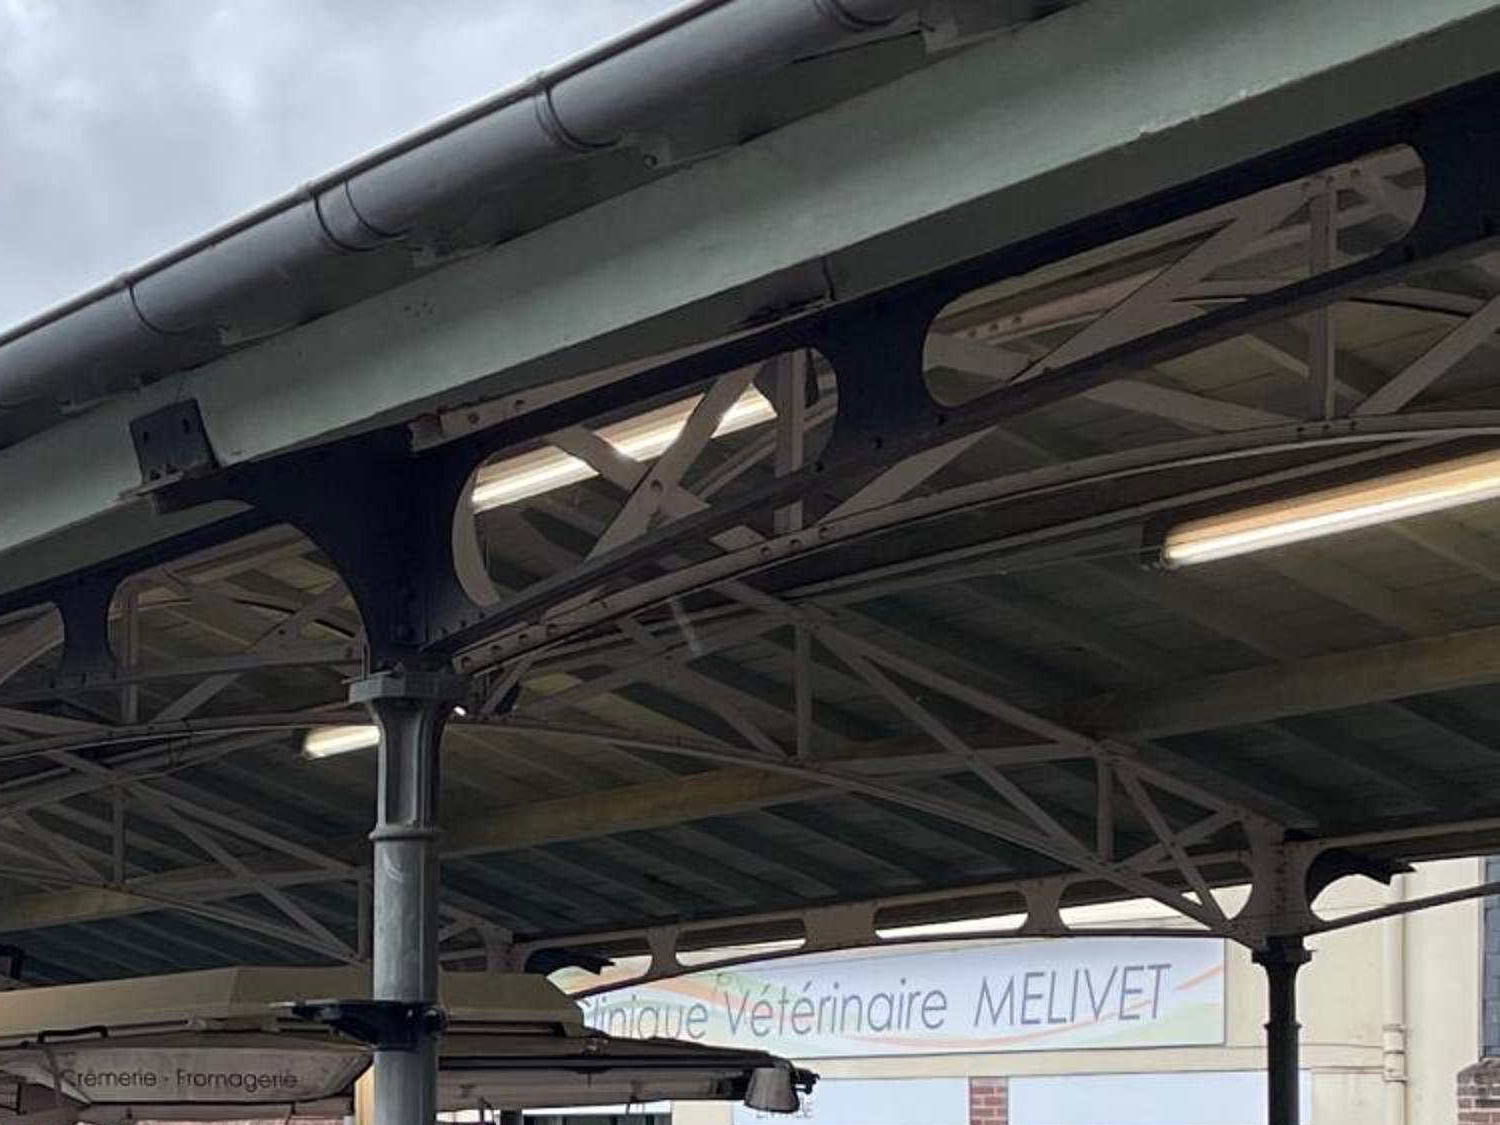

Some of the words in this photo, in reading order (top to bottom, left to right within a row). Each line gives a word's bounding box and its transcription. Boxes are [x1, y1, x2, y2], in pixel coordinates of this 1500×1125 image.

[585, 995, 708, 1040] linique
[723, 977, 947, 1037] Vétérinaire
[973, 964, 1172, 1027] MELIVET
[176, 1067, 298, 1092] Fromagerie
